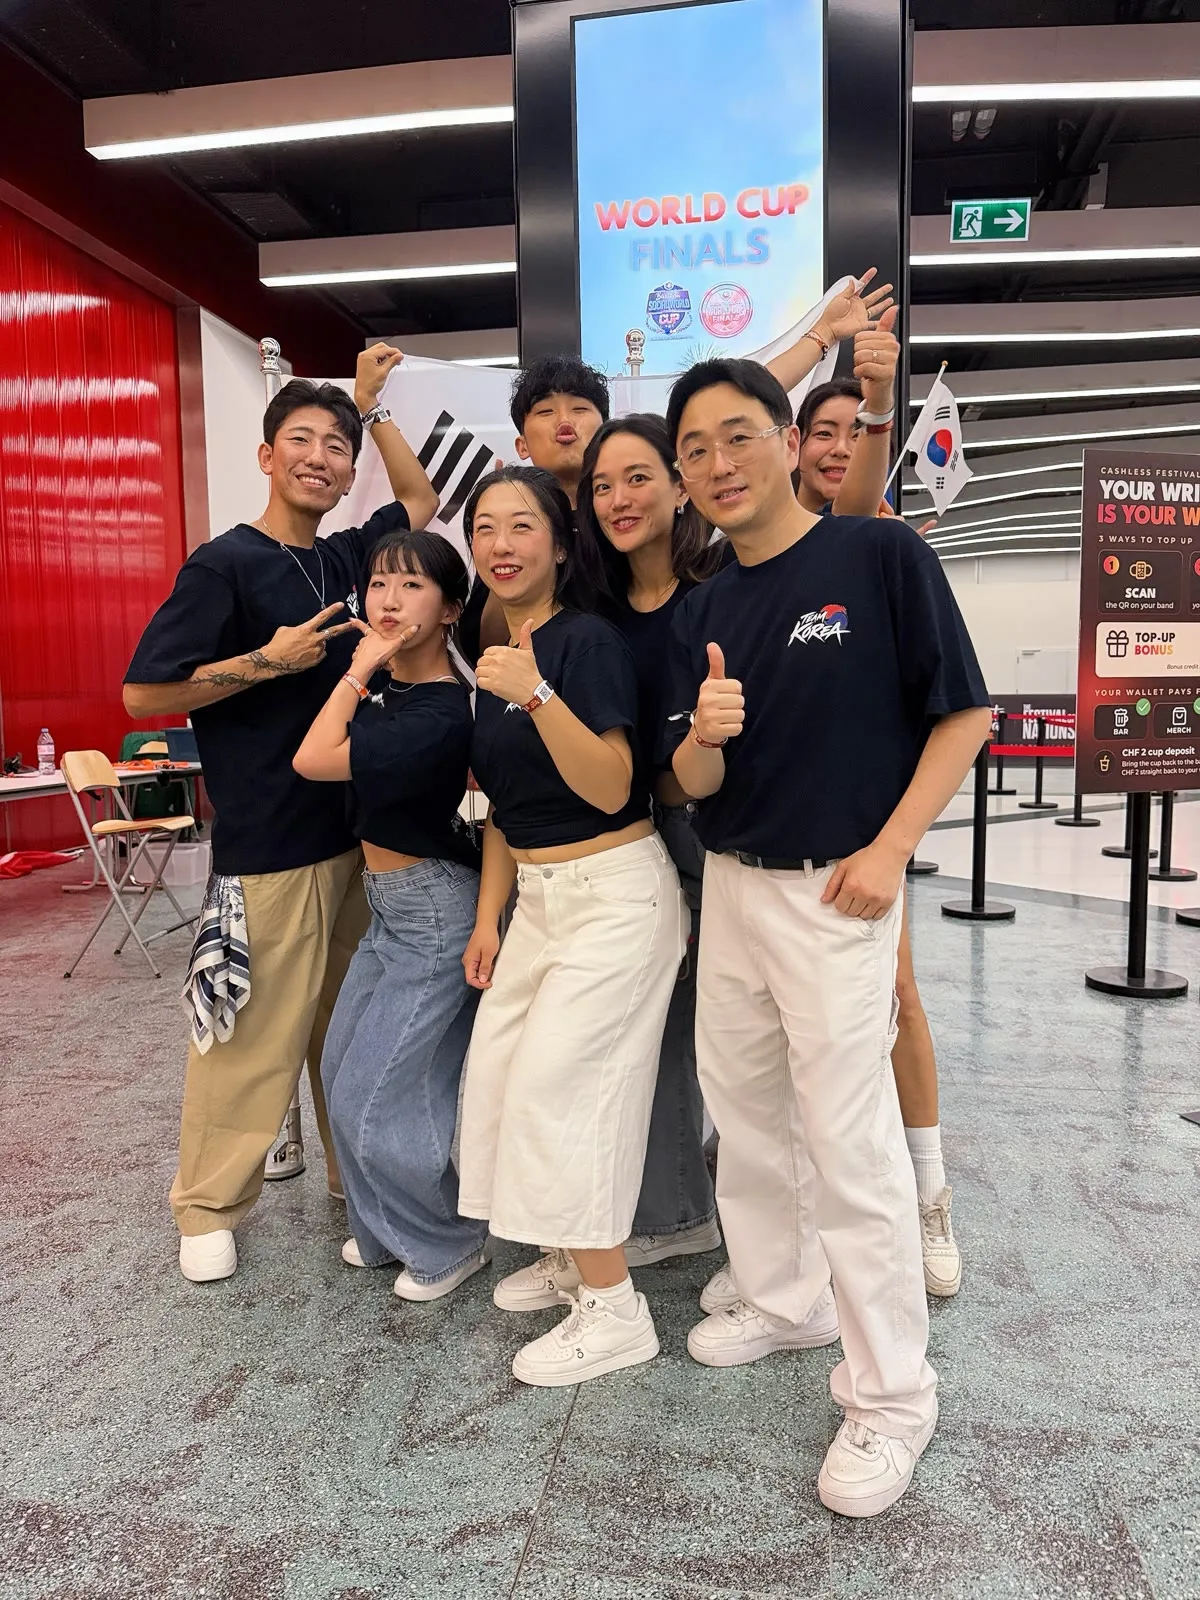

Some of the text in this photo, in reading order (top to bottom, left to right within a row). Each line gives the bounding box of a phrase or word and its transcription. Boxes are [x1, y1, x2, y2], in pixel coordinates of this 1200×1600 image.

[595, 184, 810, 231] WORLD CUP
[631, 227, 770, 271] FINALS
[659, 313, 680, 325] CUP
[1101, 467, 1200, 478] CASHLESS FESTIVAL
[1100, 480, 1155, 501] YOUR
[1097, 504, 1200, 526] IS YOUR W
[1108, 535, 1136, 543] WAYS
[1109, 561, 1114, 570] 1
[1125, 587, 1156, 599] SCAN
[1118, 602, 1130, 610] QR
[800, 611, 828, 625] TEAM
[787, 620, 851, 647] KOREA
[1135, 632, 1176, 643] TOP-UP
[1135, 644, 1173, 656] BONUS
[1094, 689, 1121, 697] YOUR
[1126, 688, 1164, 696] WALLET
[1022, 722, 1075, 740] NAIONS
[1113, 727, 1192, 736] BAR MERCH
[1122, 746, 1195, 757] CHF 2 cup deposit
[1121, 760, 1138, 768] Bring
[1150, 760, 1162, 768] cup
[1140, 768, 1163, 776] straight
[1185, 767, 1198, 775] your
